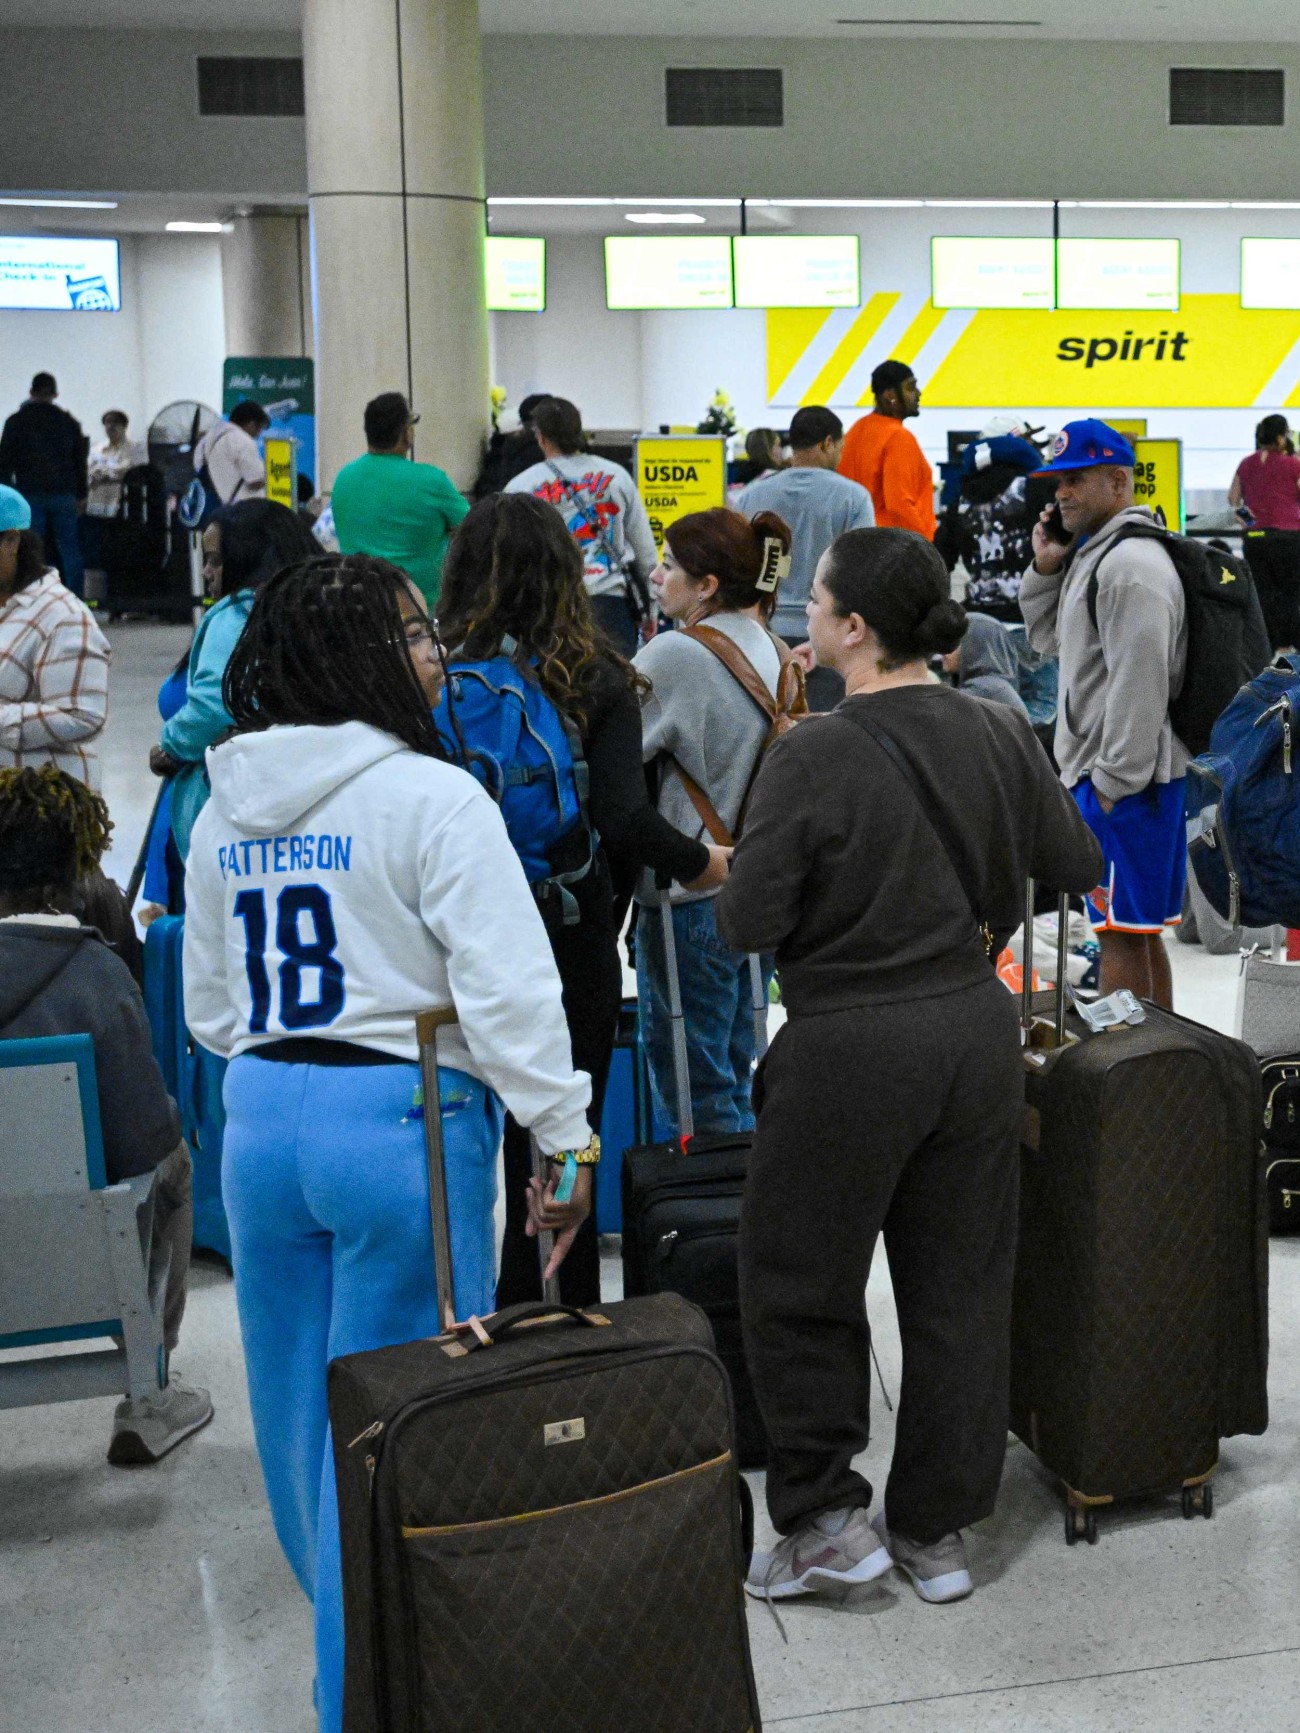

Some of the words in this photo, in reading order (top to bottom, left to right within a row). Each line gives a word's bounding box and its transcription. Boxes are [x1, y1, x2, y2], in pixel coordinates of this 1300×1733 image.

[1057, 331, 1189, 368] spirit
[645, 466, 698, 482] USDA
[1135, 461, 1156, 482] ag
[1134, 483, 1156, 497] rop
[645, 497, 678, 507] USDA
[218, 835, 352, 880] PATTERSON
[233, 883, 346, 1034] 18
